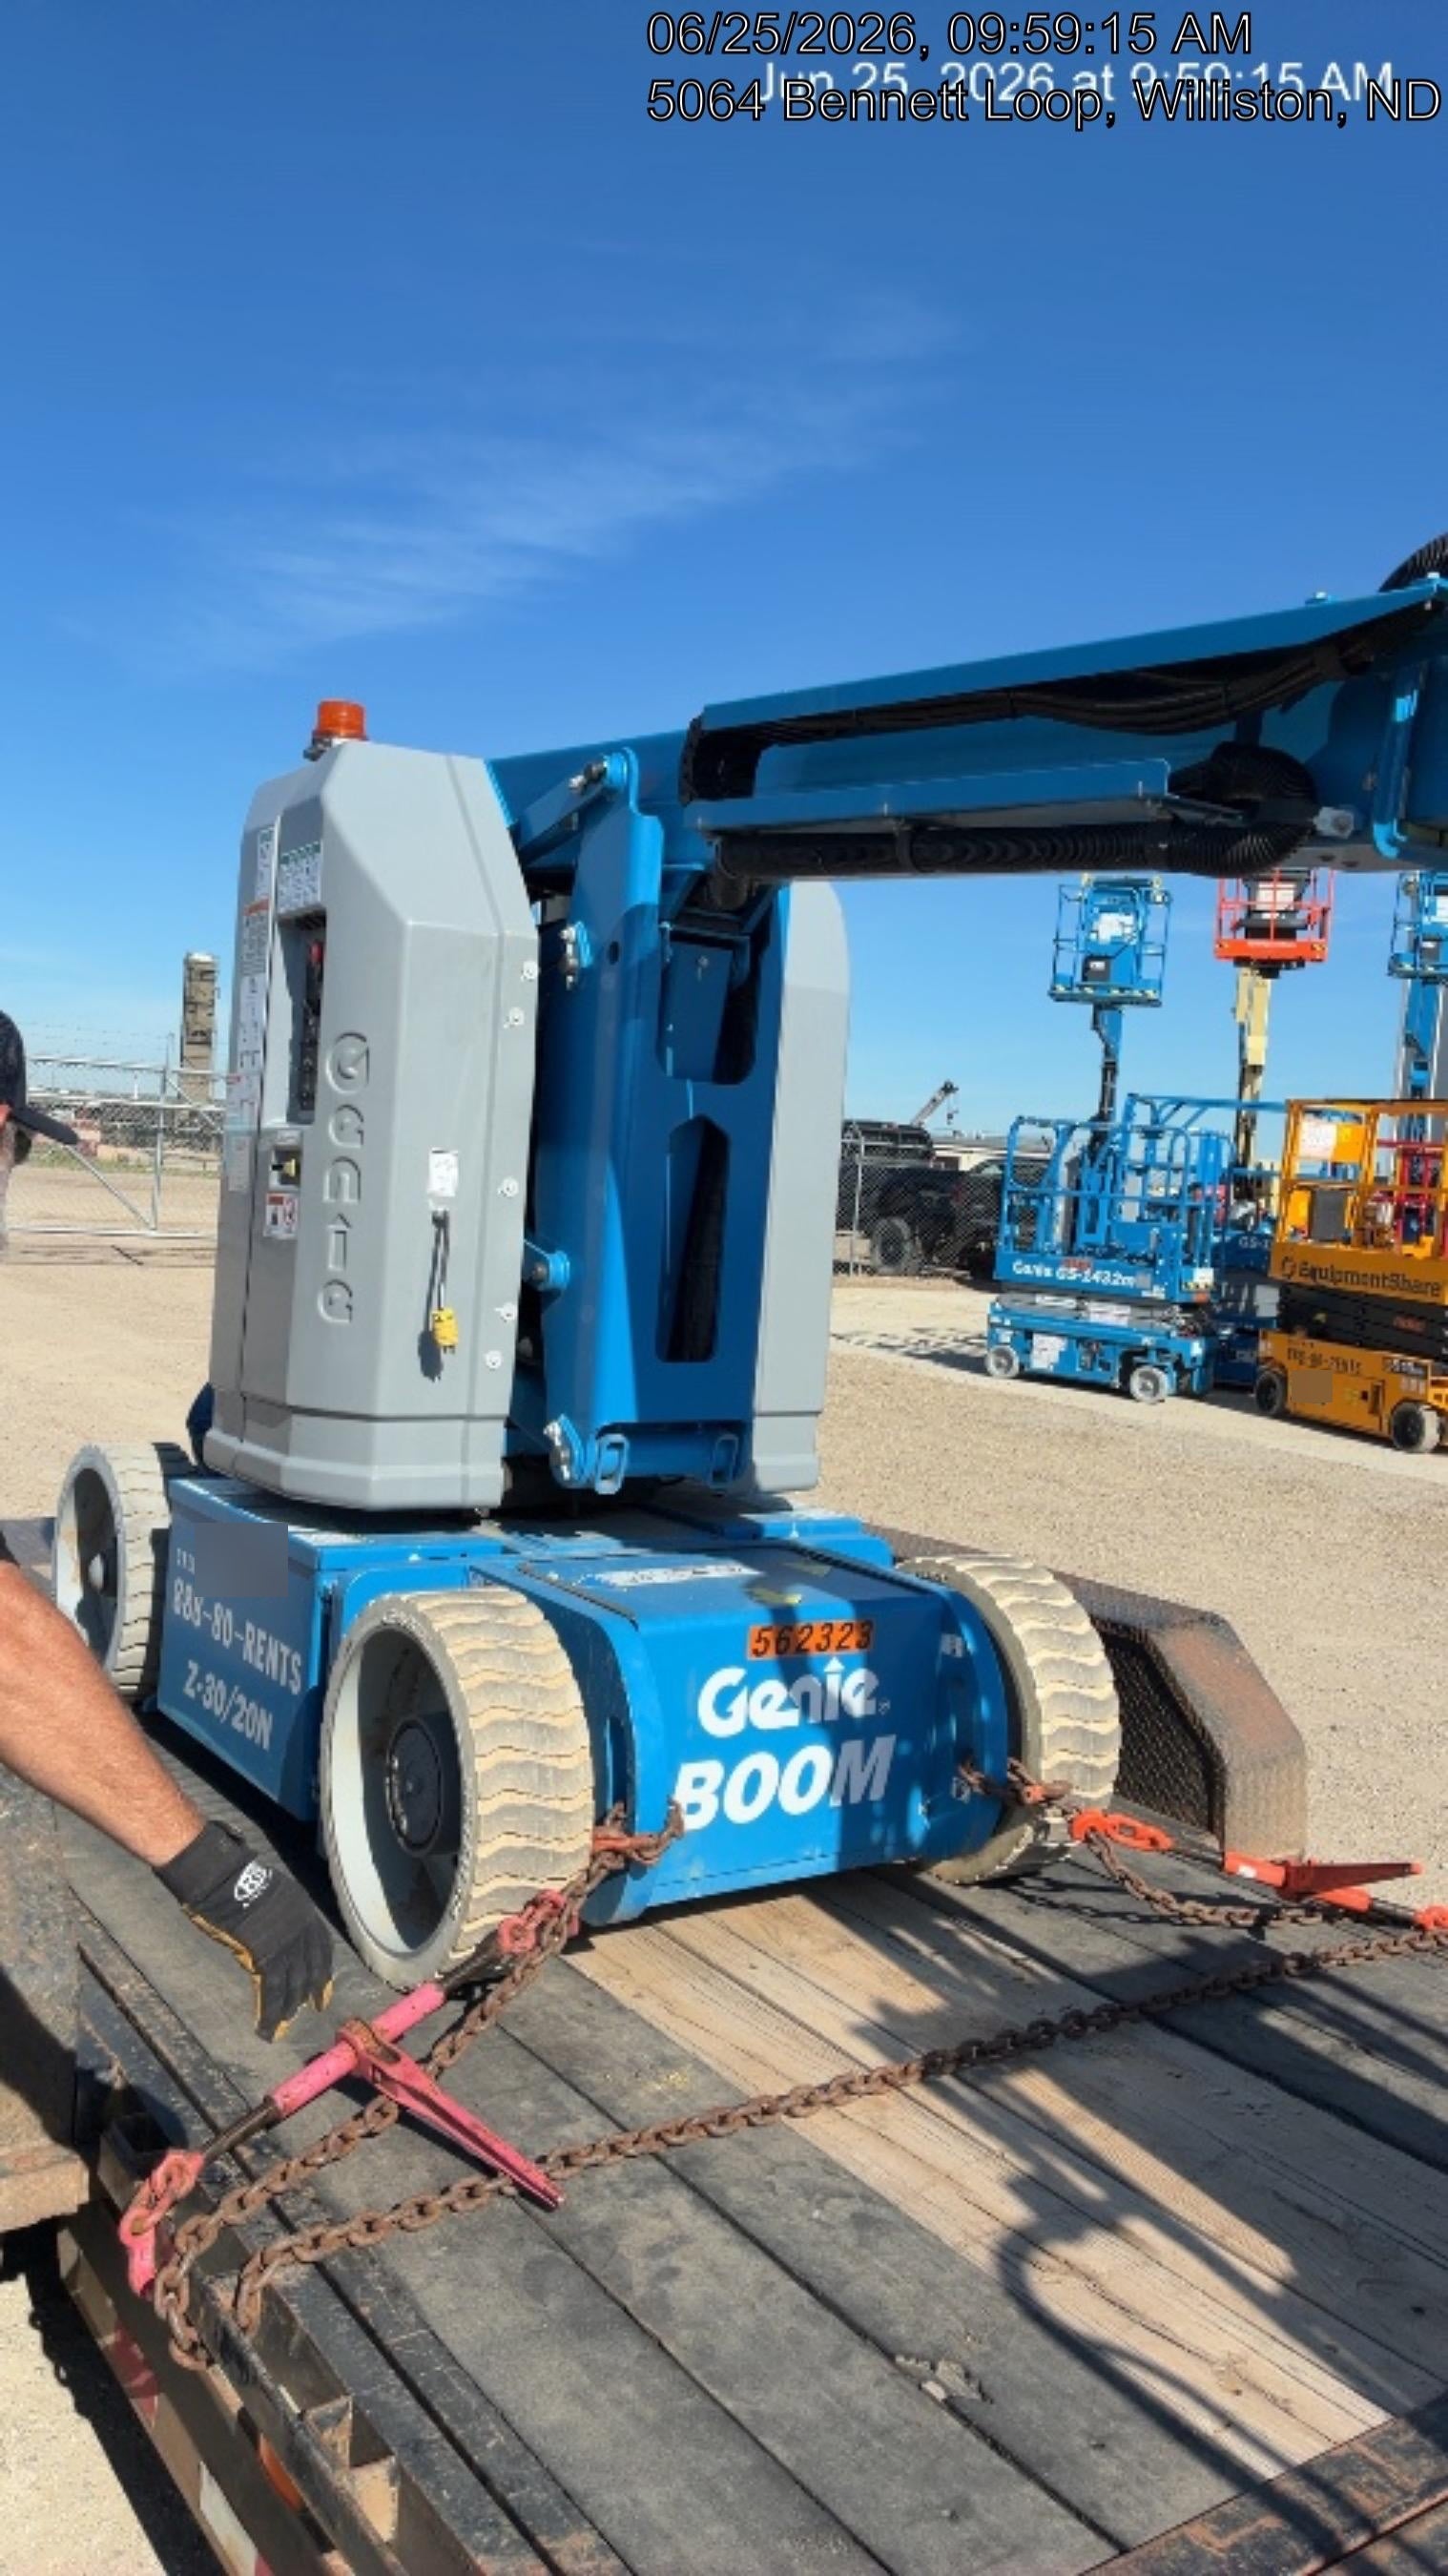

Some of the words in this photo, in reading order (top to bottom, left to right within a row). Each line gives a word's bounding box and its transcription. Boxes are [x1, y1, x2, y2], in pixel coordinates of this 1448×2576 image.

[751, 1620, 875, 1658] 562323
[697, 1655, 879, 1738] Genie
[674, 1735, 897, 1832] BOOM
